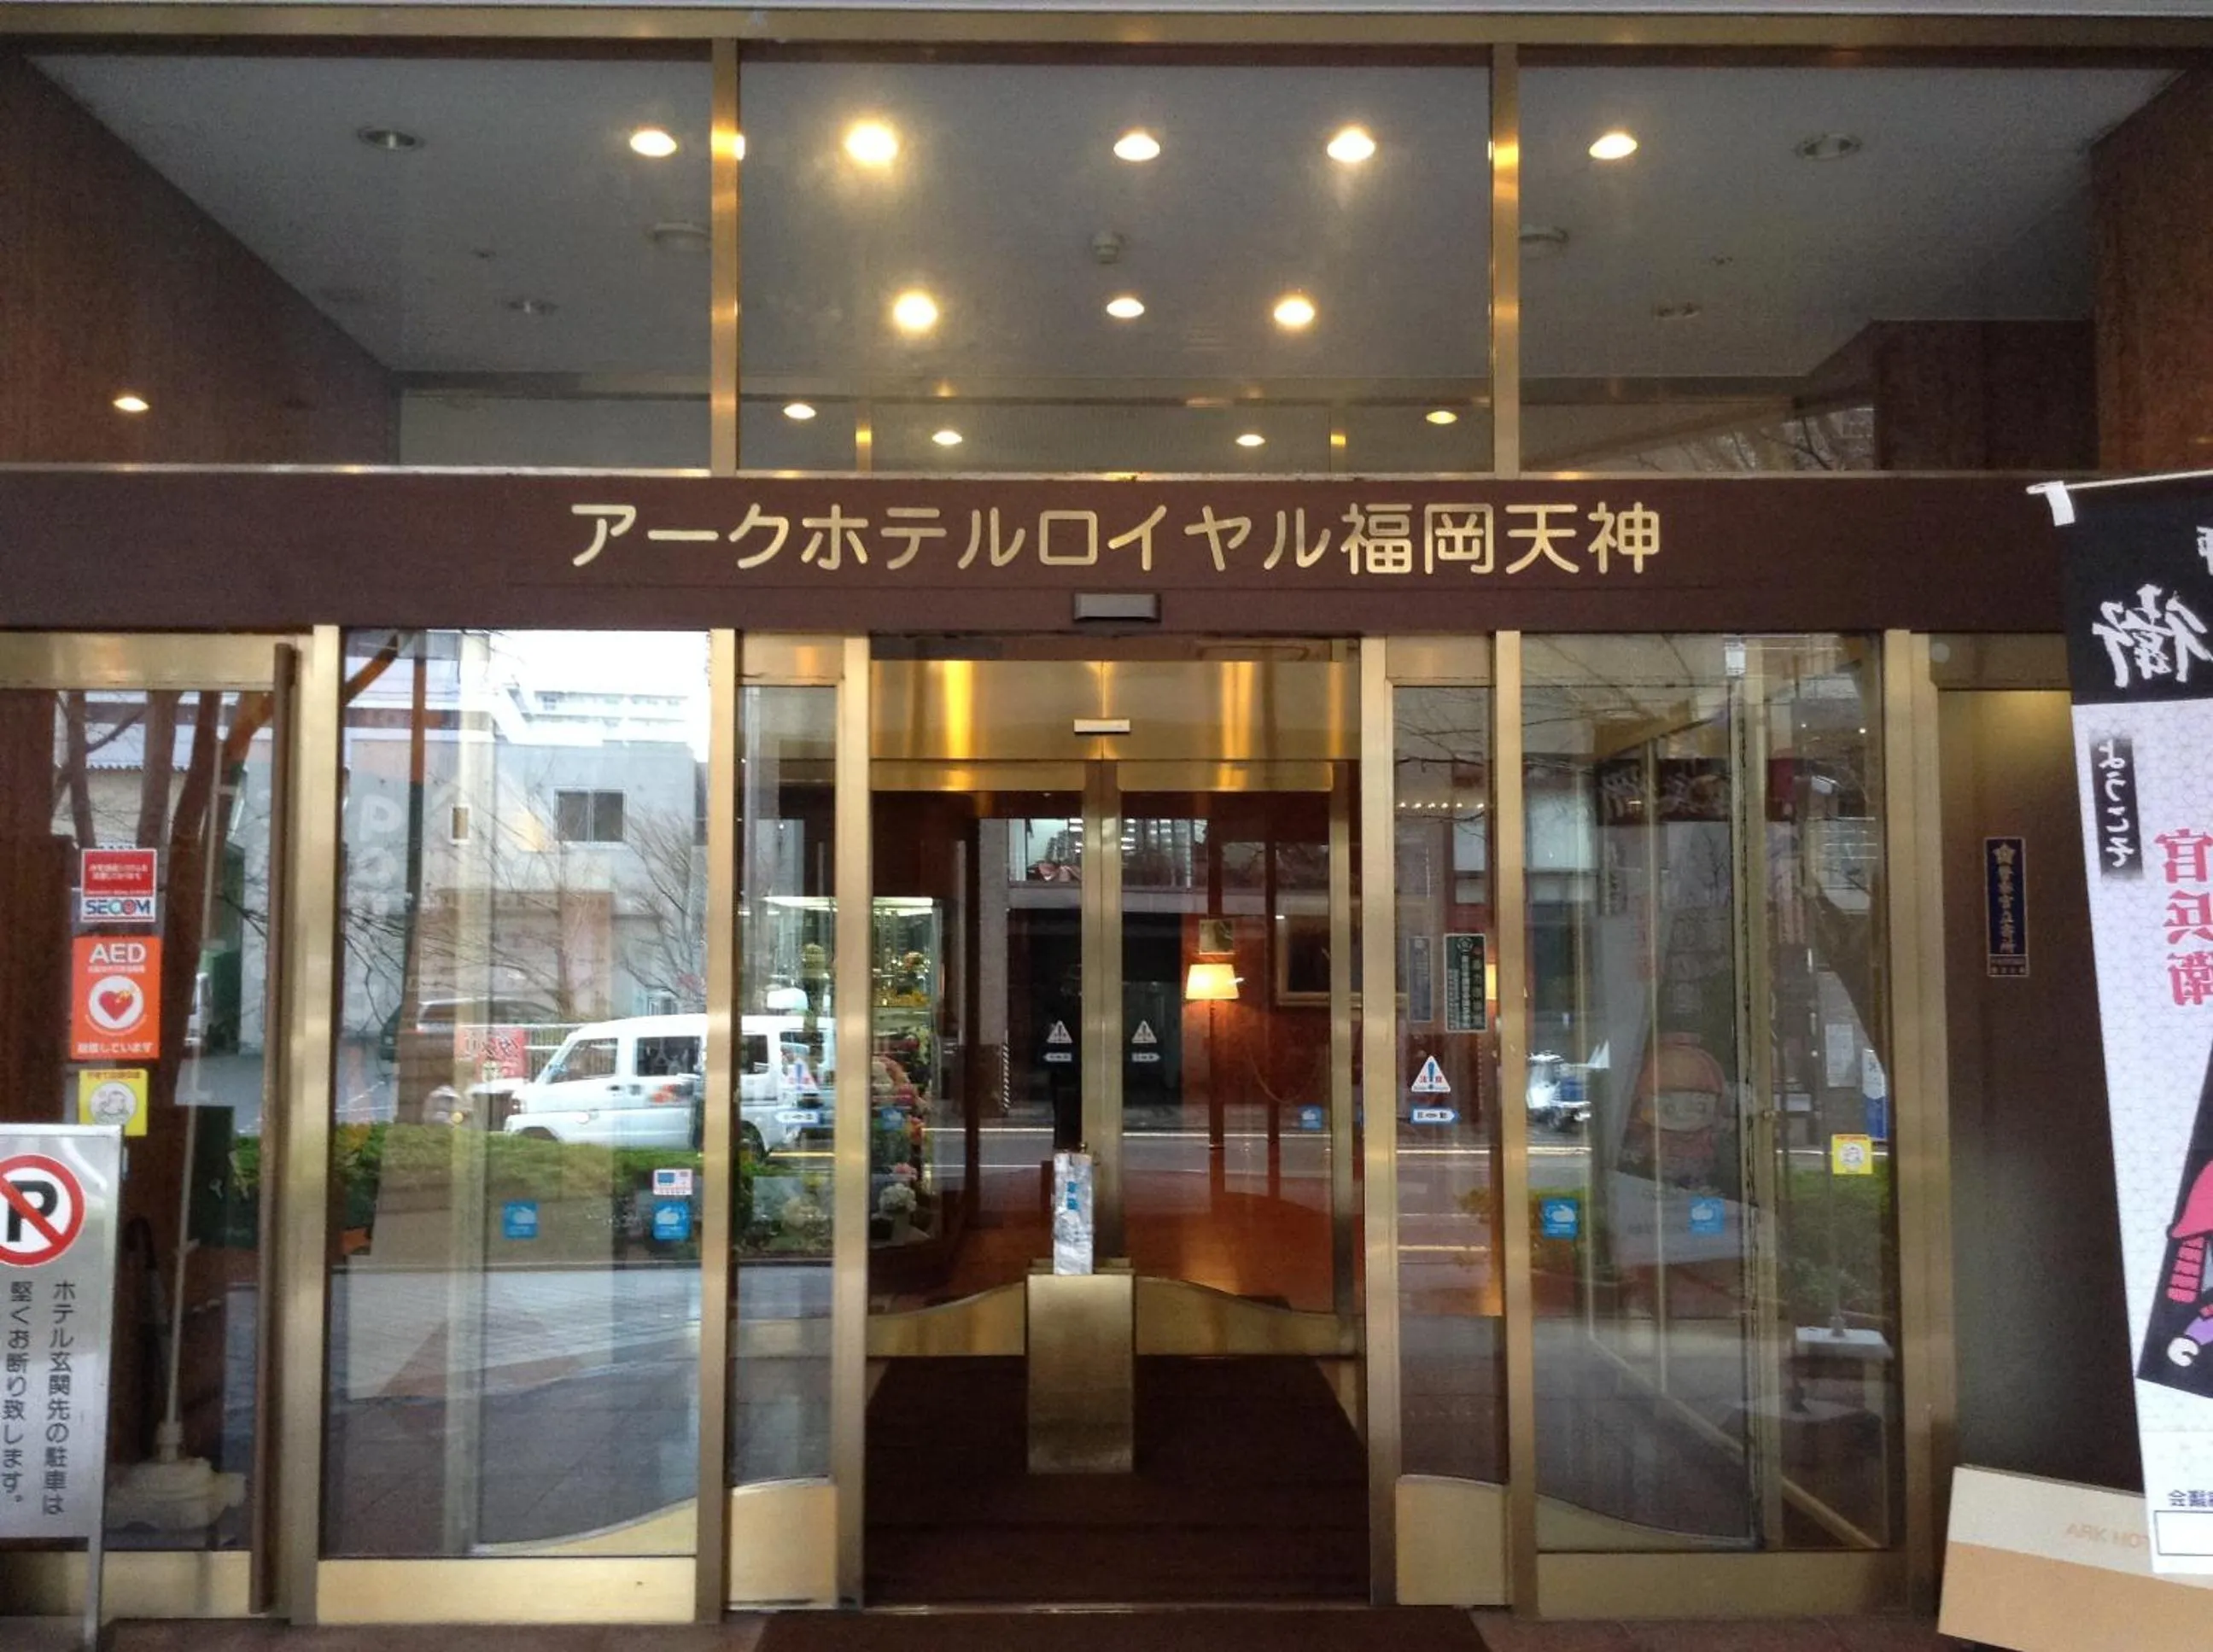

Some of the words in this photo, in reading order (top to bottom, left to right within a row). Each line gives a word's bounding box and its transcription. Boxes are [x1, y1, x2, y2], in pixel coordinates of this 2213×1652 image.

[570, 502, 1662, 575] アークホテルロイヤル福岡天神
[85, 899, 151, 915] SECOM
[90, 943, 146, 964] AED
[1, 1281, 33, 1503] 堅くお断り致します。
[43, 1280, 77, 1516] ホテル玄関先の駐車は
